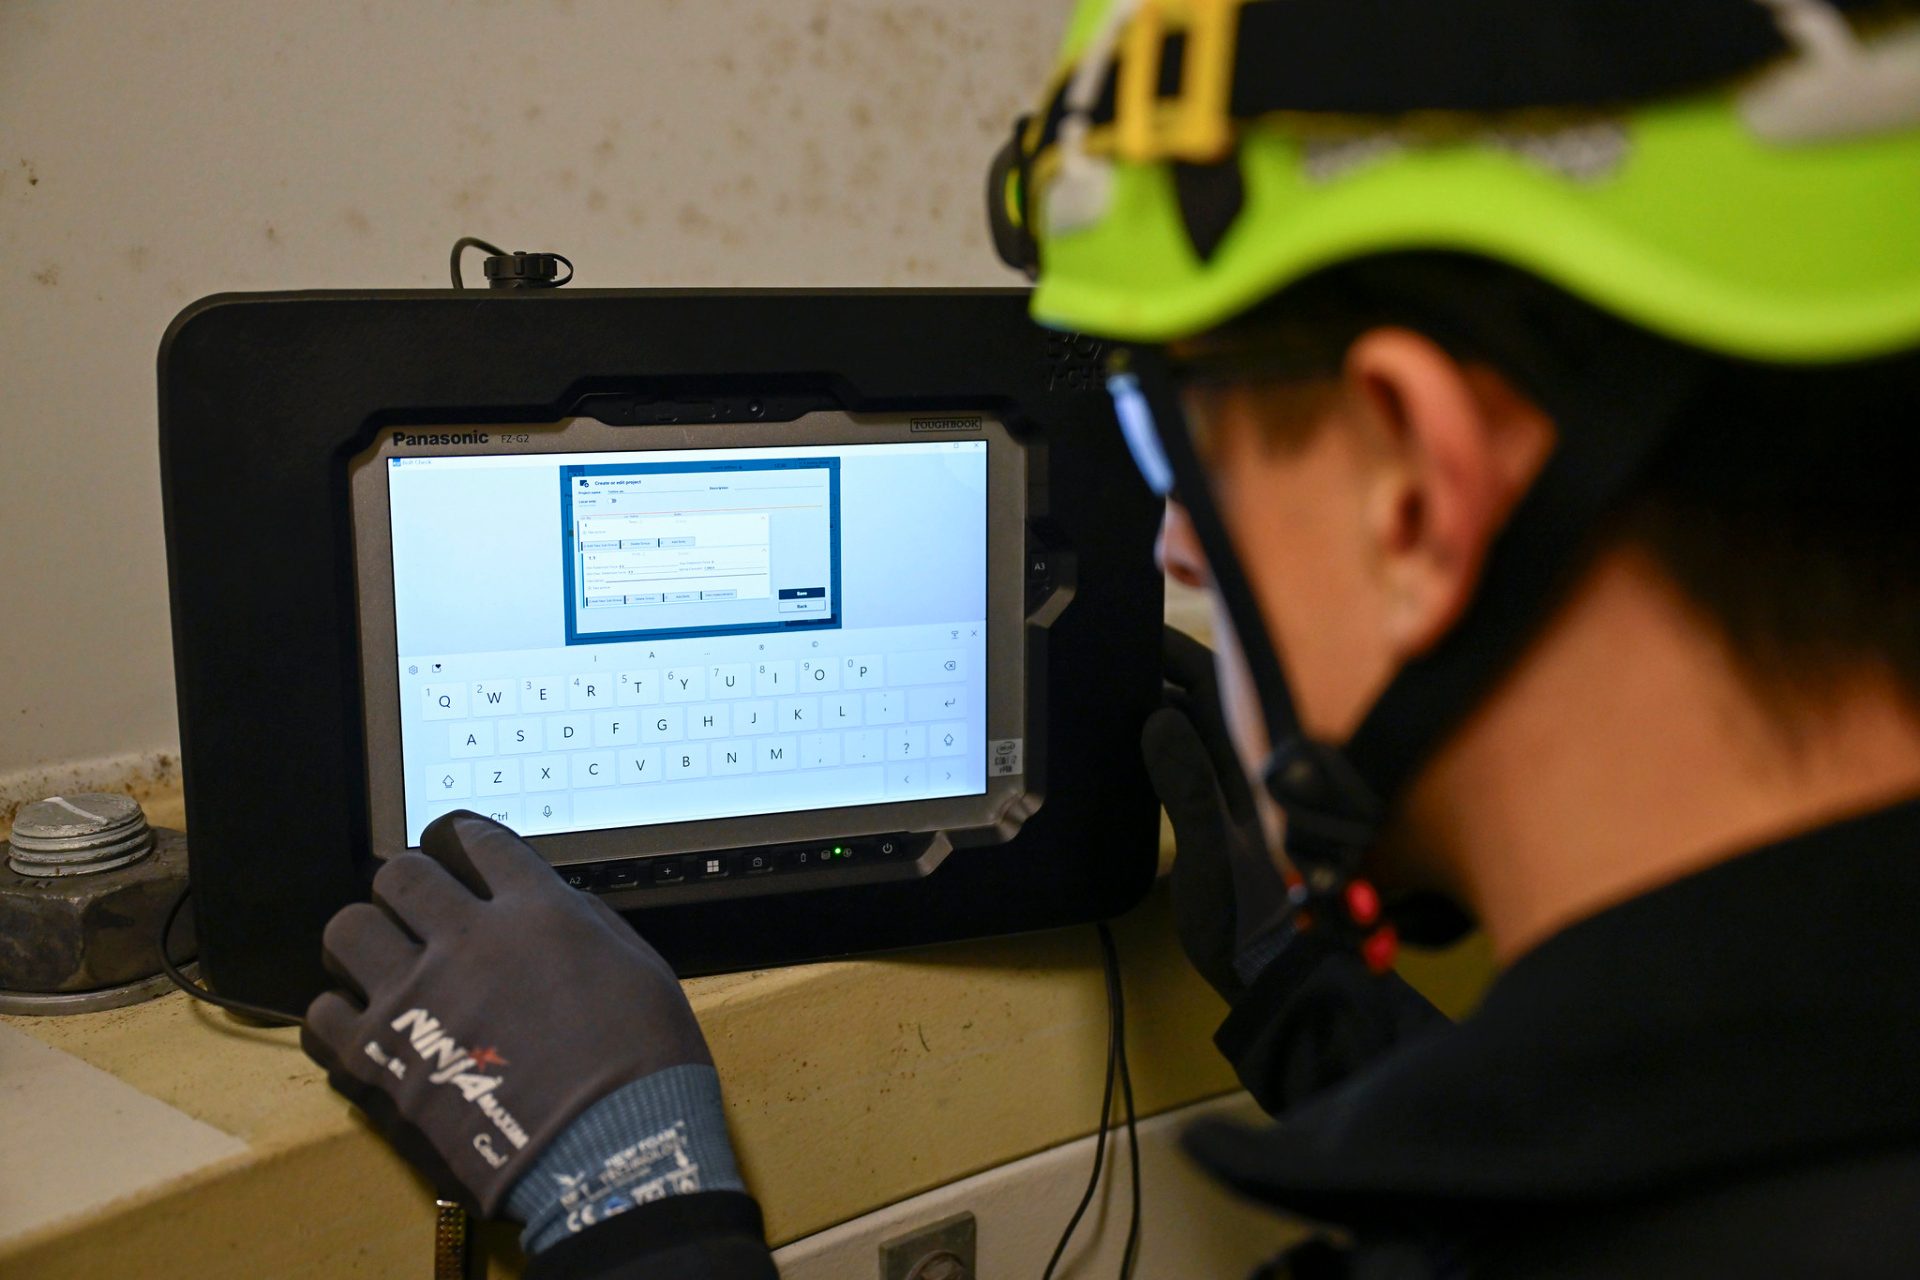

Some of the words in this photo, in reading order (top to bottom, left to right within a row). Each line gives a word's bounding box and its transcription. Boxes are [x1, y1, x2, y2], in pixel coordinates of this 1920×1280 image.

[913, 419, 979, 430] TOUGHBOOK
[392, 429, 489, 446] Panasonic
[501, 433, 529, 444] FZ-G2
[626, 479, 642, 487] project
[1034, 562, 1046, 571] A3
[648, 651, 656, 659] A
[425, 687, 431, 697] 1
[476, 683, 484, 694] 2
[525, 680, 532, 691] 3
[573, 677, 580, 687] 4
[621, 674, 628, 684] 5
[667, 670, 675, 681] 6
[713, 667, 720, 678] 7
[759, 664, 766, 675] 8
[803, 661, 810, 672] 9
[847, 658, 854, 669] 0
[438, 694, 451, 709] Q
[485, 691, 503, 705] W
[539, 687, 548, 701] E
[586, 684, 597, 698] R
[633, 681, 643, 694] T
[679, 678, 689, 691] Y
[725, 674, 736, 688] U
[813, 668, 826, 682] O
[859, 665, 868, 678] P
[466, 733, 478, 747] A
[515, 729, 525, 743] S
[563, 725, 575, 739] D
[612, 722, 620, 735] F
[656, 718, 668, 732] G
[703, 714, 714, 728] H
[750, 711, 757, 725] J
[794, 708, 803, 721] K
[839, 705, 847, 718] L
[492, 770, 504, 784] Z
[540, 767, 551, 780] X
[588, 762, 599, 776] C
[634, 759, 646, 772] V
[681, 755, 691, 768] B
[726, 751, 737, 764] N
[770, 747, 783, 761] M
[490, 811, 509, 823] Ctrl
[569, 876, 582, 885] A2
[390, 1008, 504, 1102] NINJA
